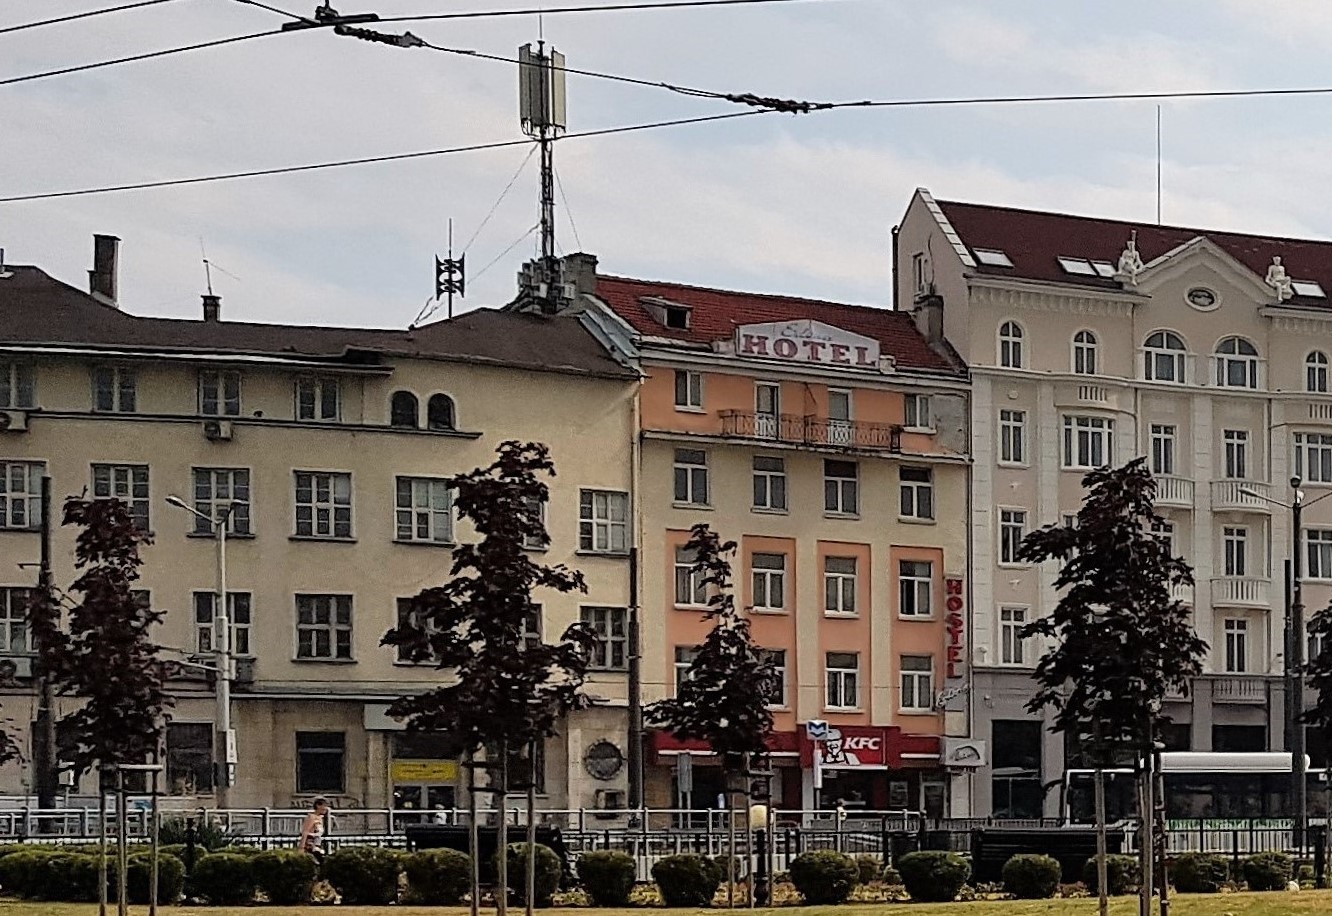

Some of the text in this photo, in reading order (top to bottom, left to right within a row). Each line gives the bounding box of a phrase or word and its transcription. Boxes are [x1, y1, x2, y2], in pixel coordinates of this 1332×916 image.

[741, 333, 877, 366] HOTEL
[946, 579, 964, 679] HOSTEL
[843, 737, 882, 750] KFC
